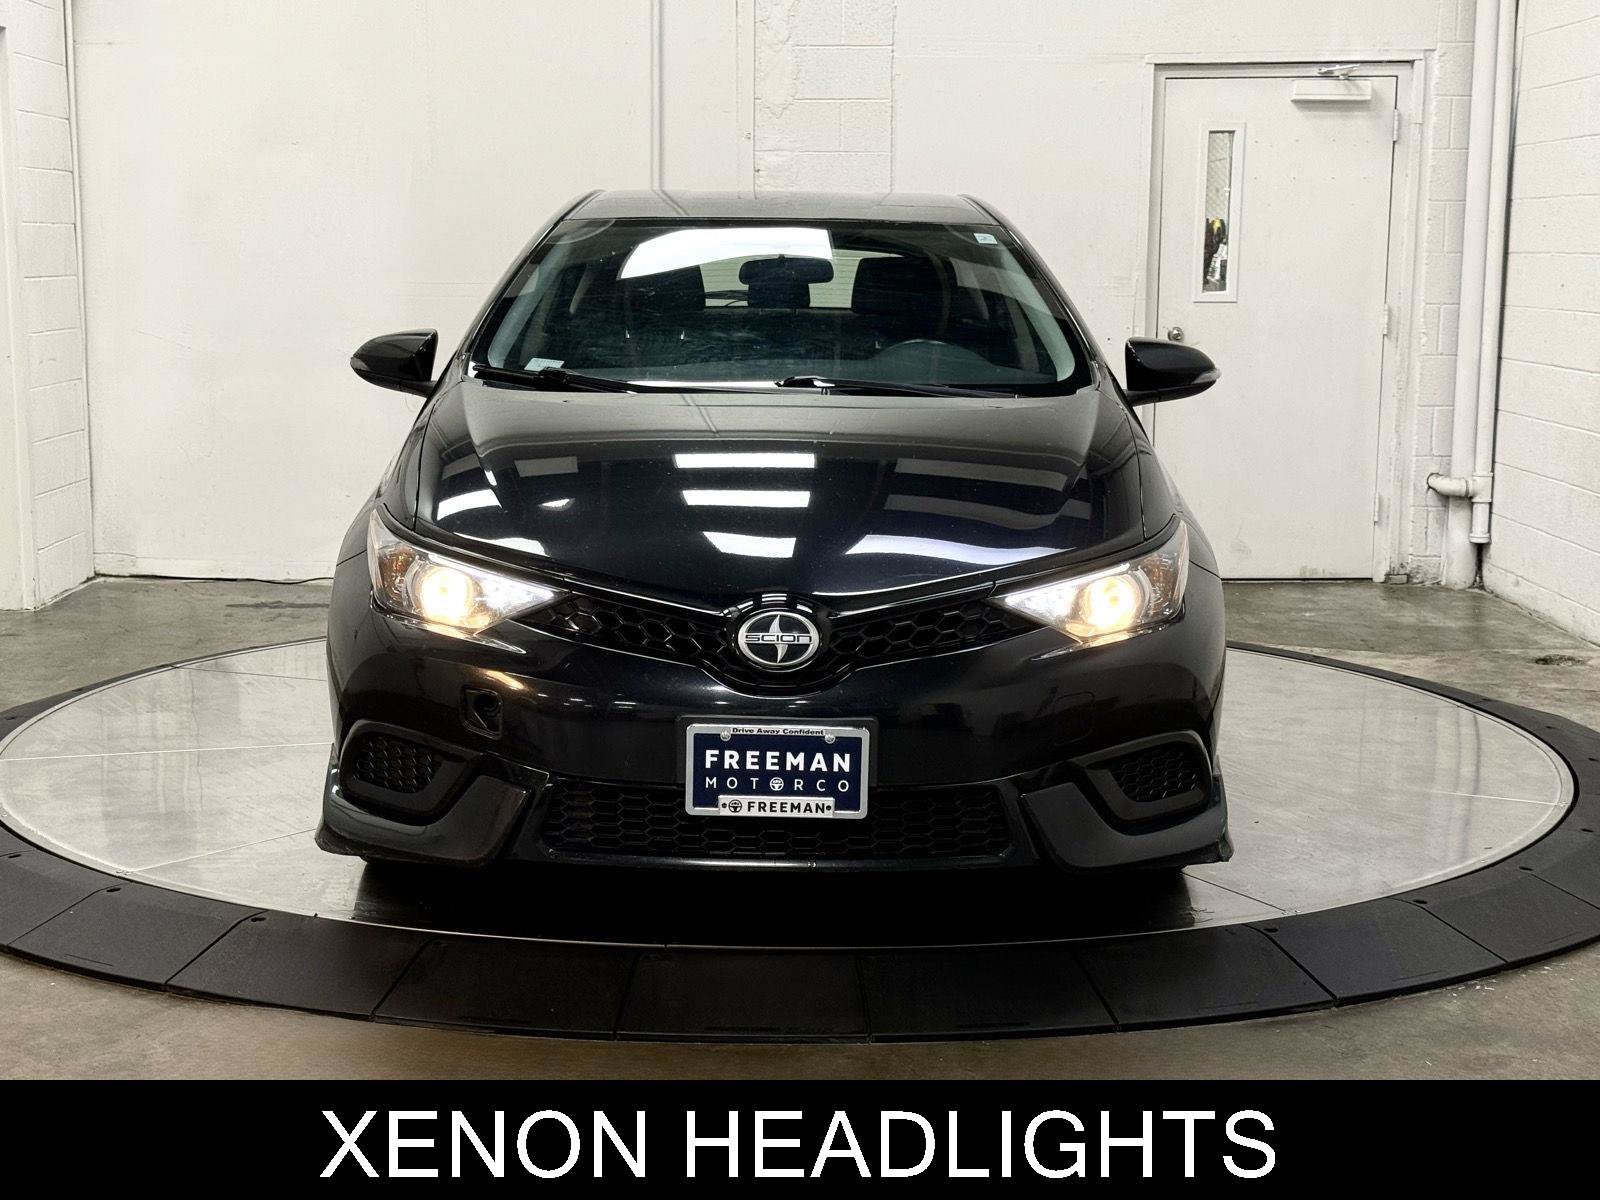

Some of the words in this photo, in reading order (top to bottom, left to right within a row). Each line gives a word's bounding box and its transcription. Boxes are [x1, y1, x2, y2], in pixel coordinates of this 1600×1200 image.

[745, 634, 812, 643] SCION
[782, 728, 824, 736] Confident
[705, 749, 850, 772] FREEMAN
[747, 801, 826, 814] FREEMAN
